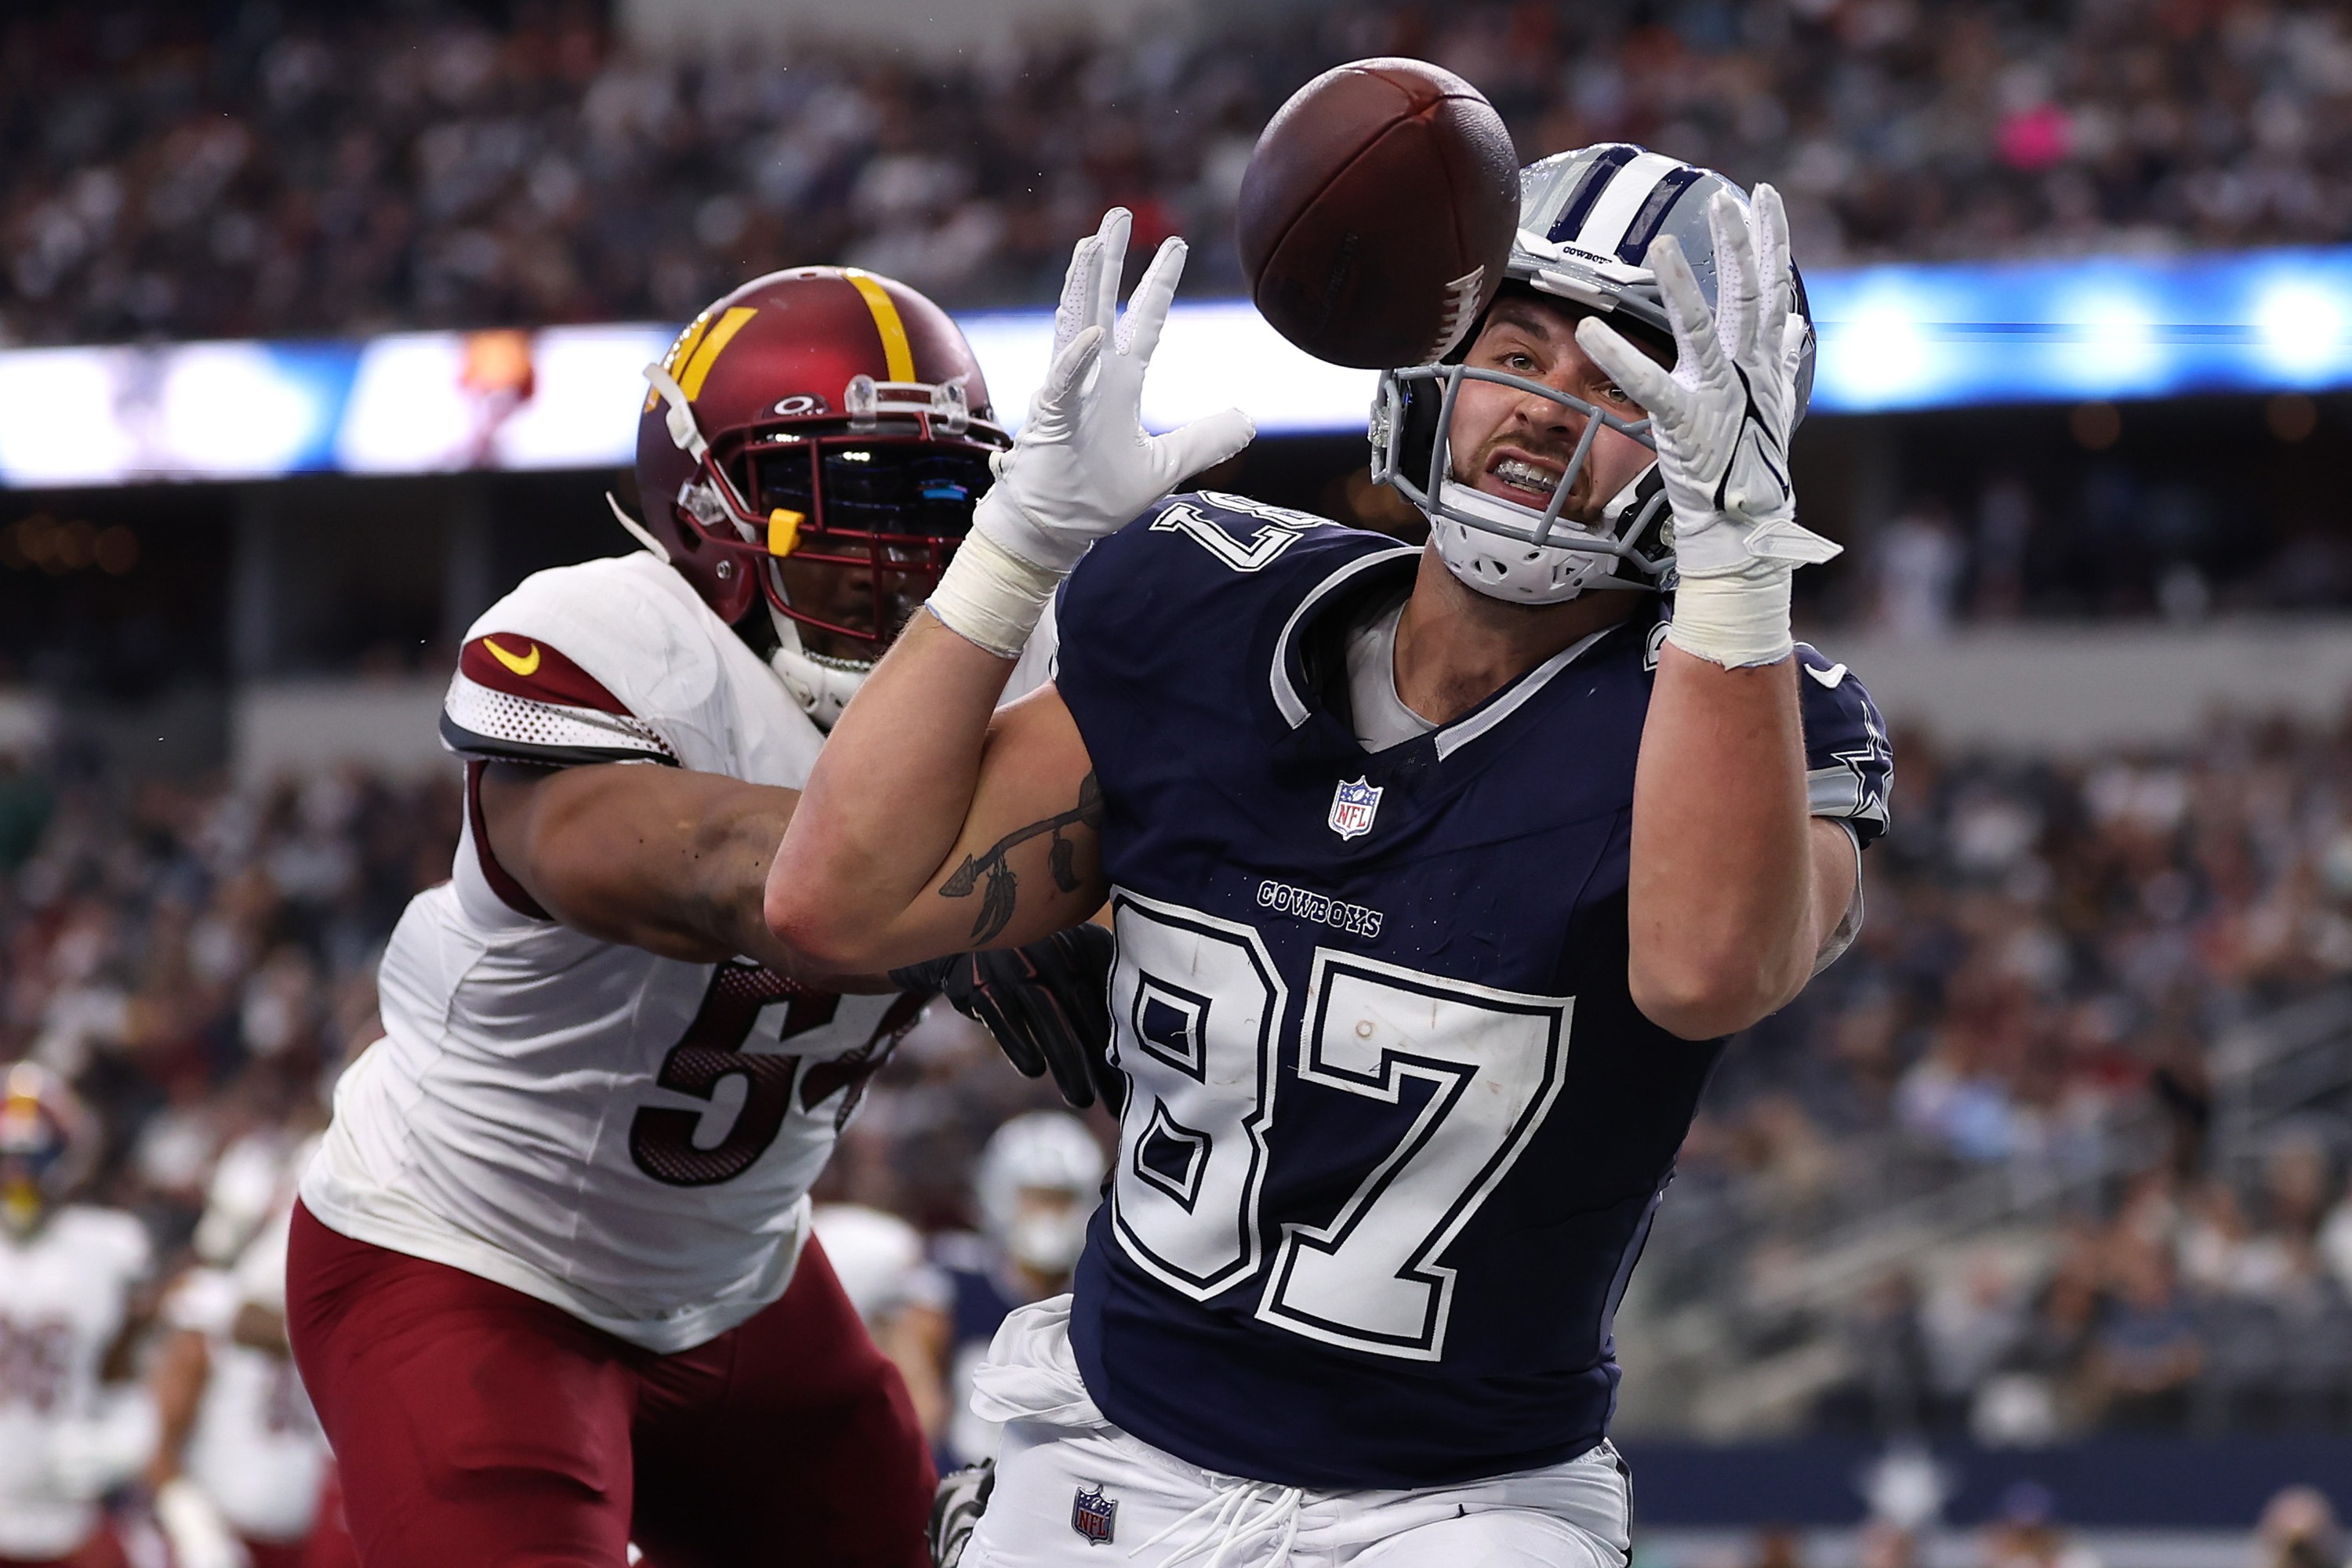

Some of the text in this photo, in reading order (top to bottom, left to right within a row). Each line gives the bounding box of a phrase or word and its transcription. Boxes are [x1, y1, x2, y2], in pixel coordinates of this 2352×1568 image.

[1336, 804, 1367, 829] NFL
[1257, 880, 1384, 938] COWBOYS
[1106, 884, 1576, 1363] 87
[1078, 1508, 1107, 1537] NFL
